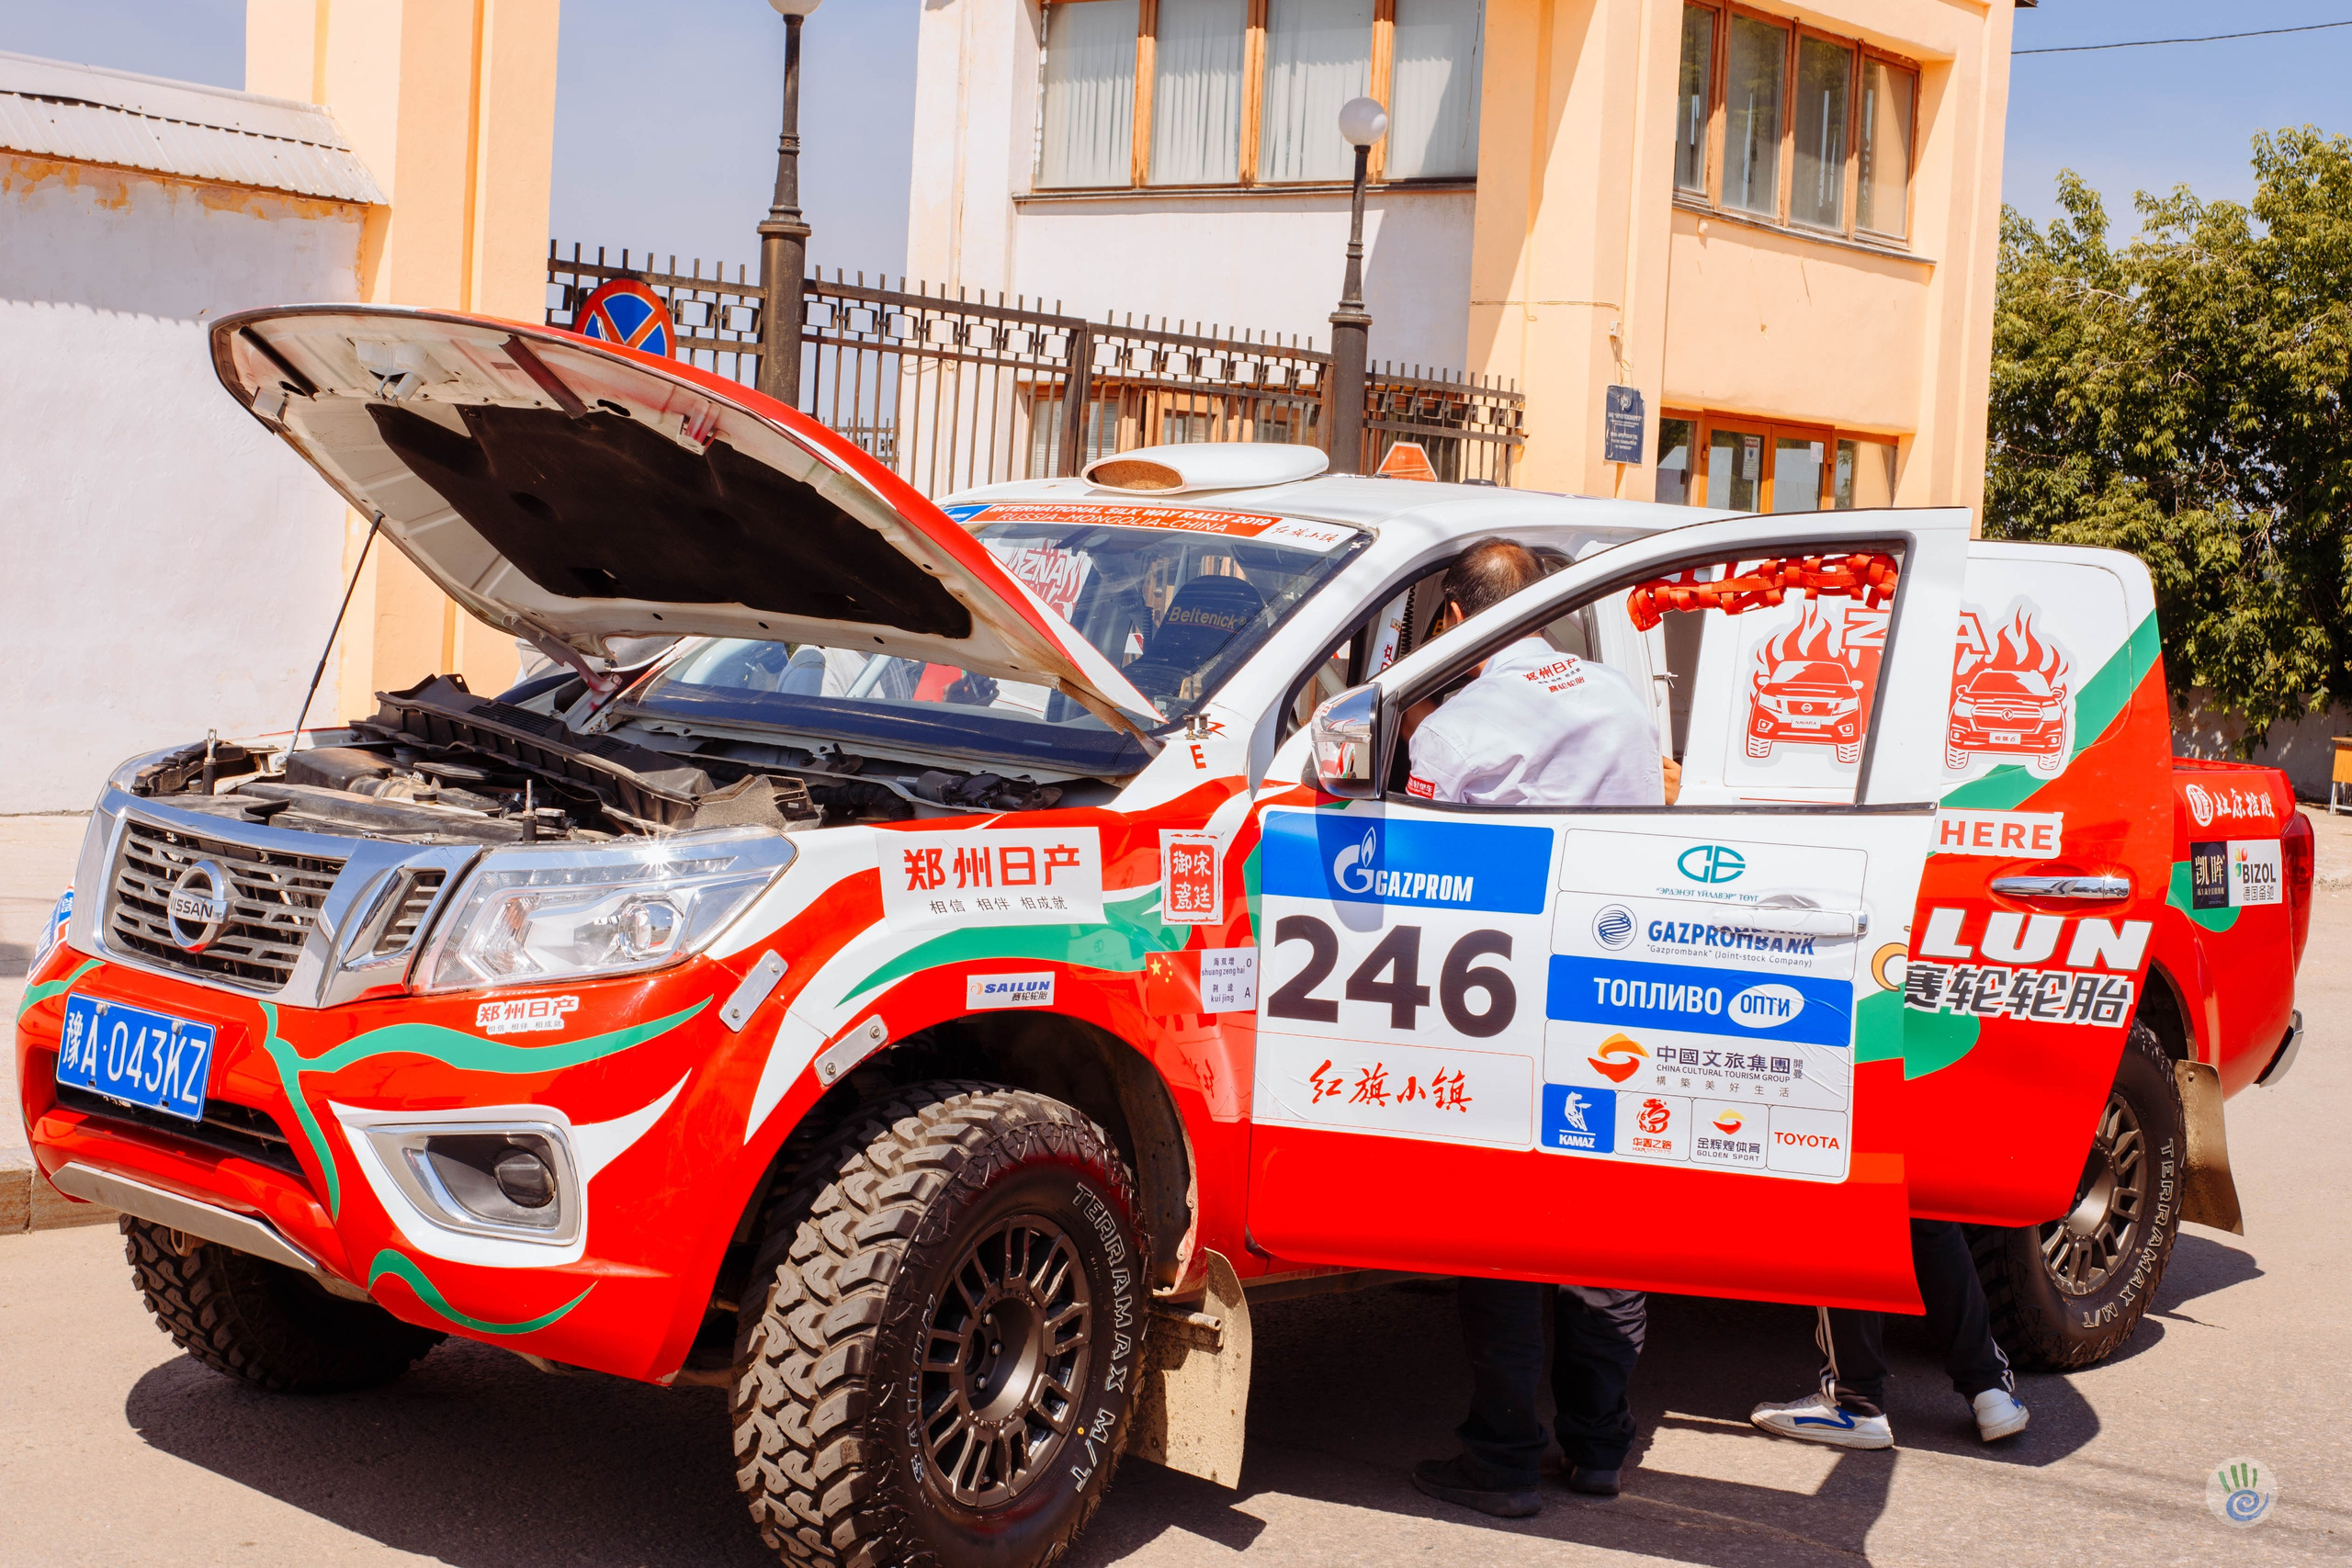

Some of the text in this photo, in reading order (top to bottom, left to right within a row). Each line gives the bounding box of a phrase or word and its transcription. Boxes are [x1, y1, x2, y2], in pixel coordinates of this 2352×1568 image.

[989, 505, 1272, 526] INTERNATIONAL SILK WAY RALLY 2019
[1939, 819, 2054, 852] HERE
[903, 843, 1082, 891] 郑州日产
[2242, 863, 2277, 884] BIZOL
[1374, 870, 1475, 903] GAZPROM
[170, 896, 214, 919] NISSAN
[929, 896, 1069, 915] 相信 相伴 相成就
[1714, 951, 1766, 964] (Joint-stock
[1769, 955, 1813, 968] Company)
[984, 980, 1051, 994] SAILUN
[1267, 914, 1518, 1039] 246
[1012, 991, 1048, 1002] 赛轮轮胎
[1244, 987, 1251, 998] A
[1593, 976, 1792, 1018] ТОПЛИВО ОПТИ
[1904, 965, 2129, 1023] 赛轮轮胎
[480, 998, 575, 1023] 郑州日产
[1657, 1045, 1791, 1075] 中國文旅集團
[1657, 1064, 1791, 1084] CHINA CULTURAL TOURISM GROUP
[1309, 1059, 1474, 1114] 红旗小镇
[1559, 1133, 1597, 1149] KAMAZ
[1774, 1132, 1840, 1150] TOYOTA
[1696, 1149, 1760, 1162] GOLDEN SPORT
[2081, 1138, 2175, 1328] TERRAMAX M/T
[1070, 1181, 1134, 1494] TERRAMAX M/T
